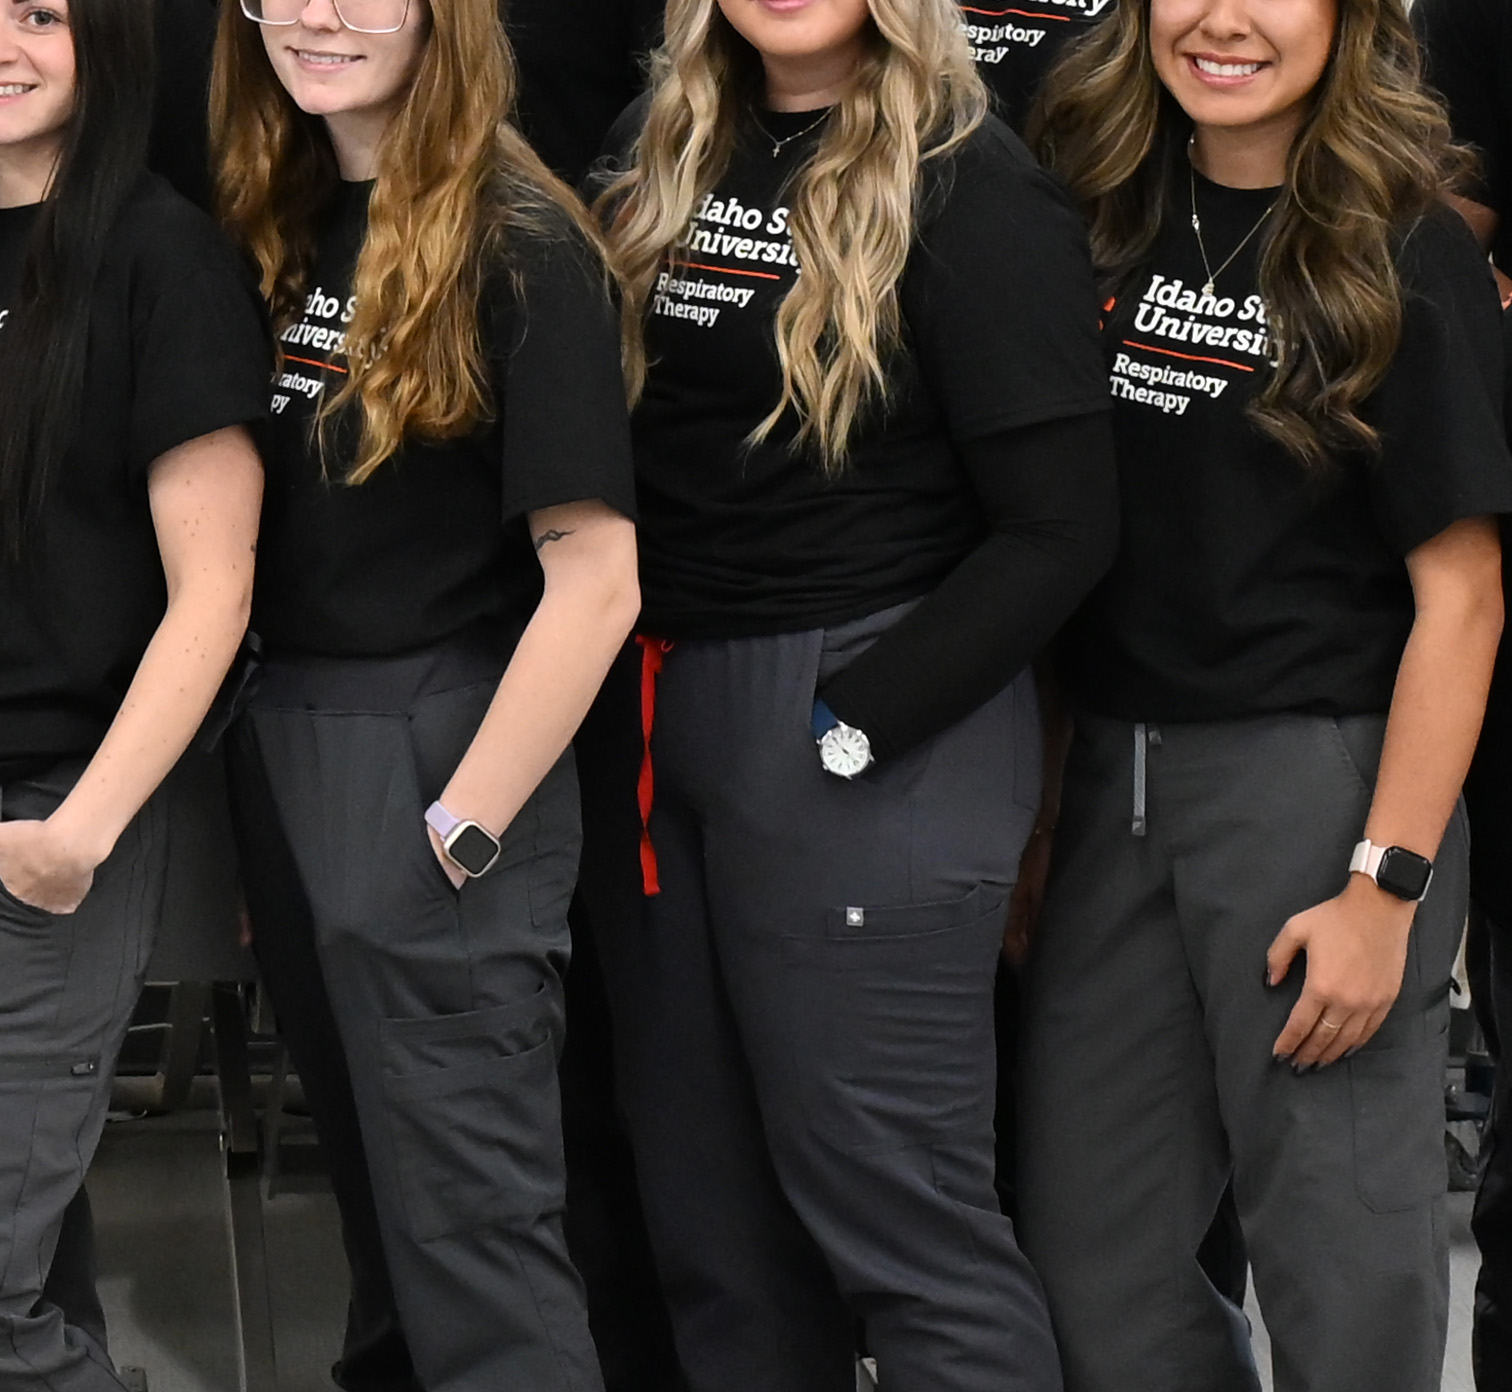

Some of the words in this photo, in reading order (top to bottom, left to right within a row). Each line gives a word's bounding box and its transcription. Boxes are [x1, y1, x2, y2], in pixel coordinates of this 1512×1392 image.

[695, 193, 763, 230] daho
[657, 272, 755, 308] Respiratory
[1143, 274, 1235, 318] Idaho
[654, 295, 720, 328] Therapy
[278, 372, 324, 399] ratory
[1113, 353, 1228, 398] Respiratory
[1109, 376, 1190, 415] Therapy
